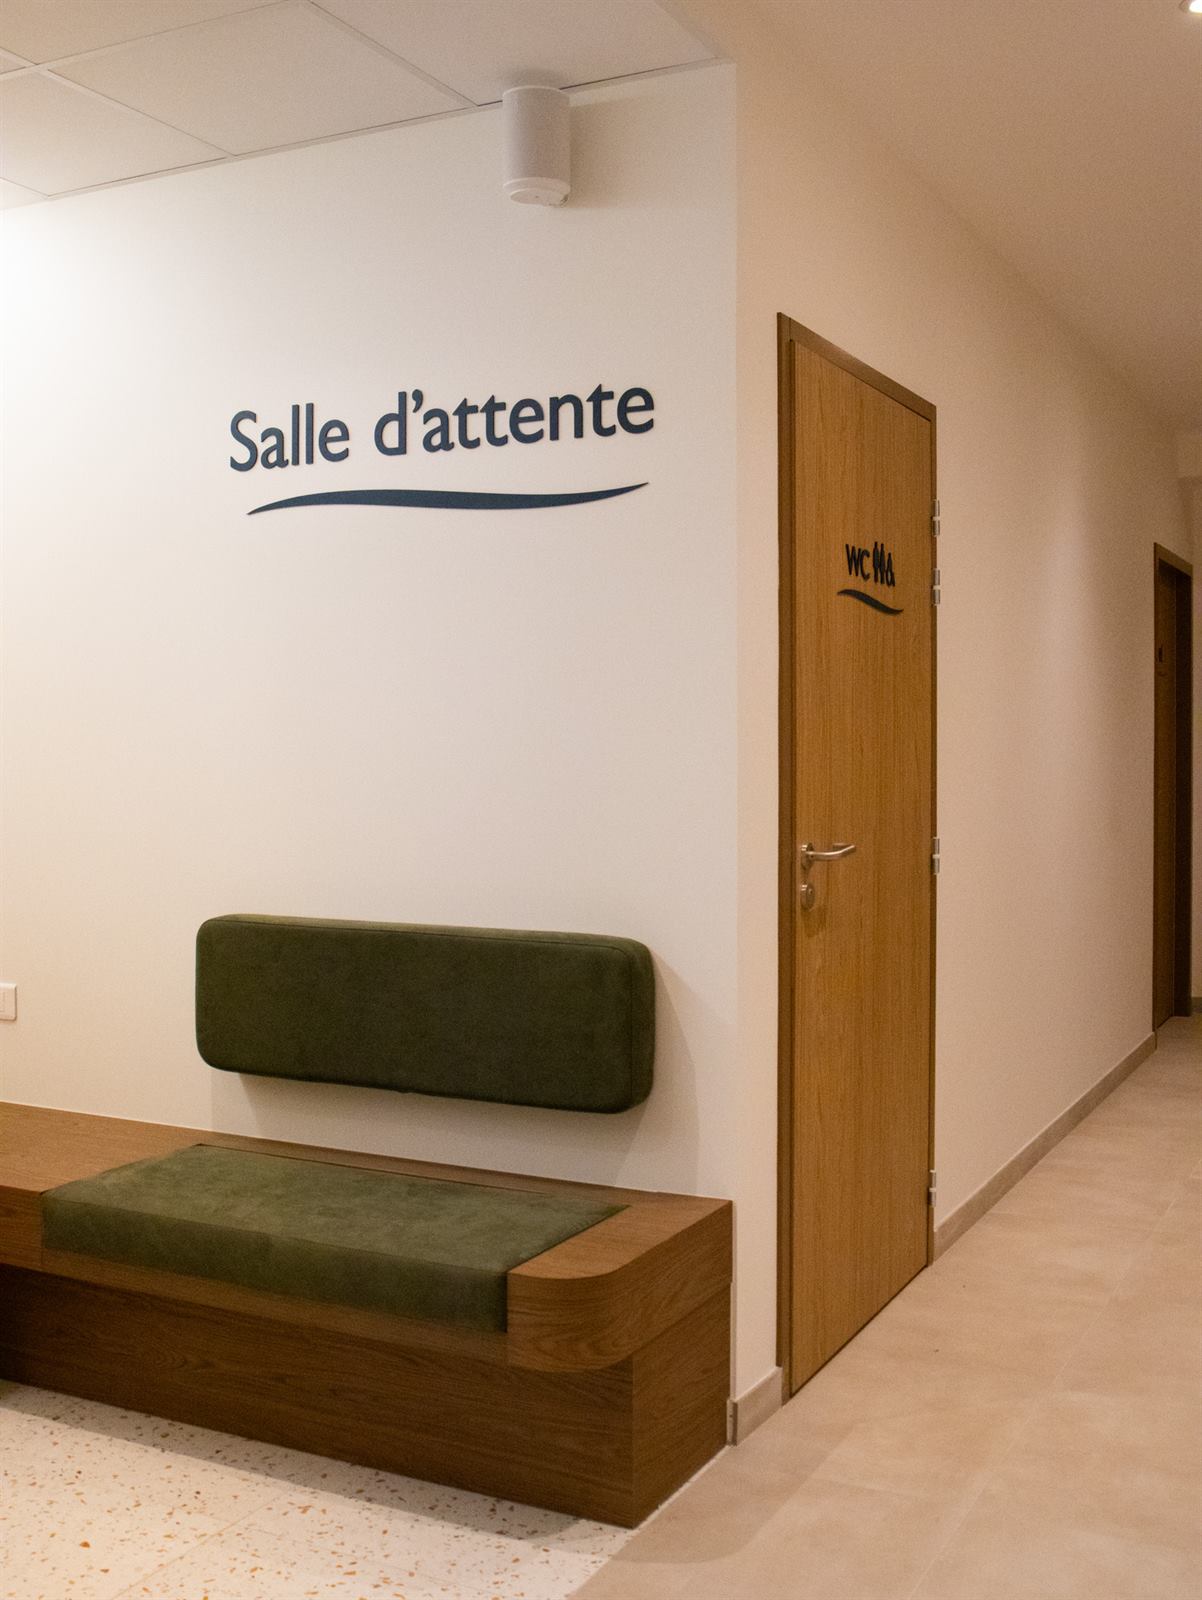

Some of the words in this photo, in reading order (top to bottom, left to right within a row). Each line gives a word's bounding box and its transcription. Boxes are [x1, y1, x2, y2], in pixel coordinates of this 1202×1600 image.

[230, 402, 350, 472] Salle
[374, 383, 655, 456] d’attente
[845, 543, 871, 582] WC
